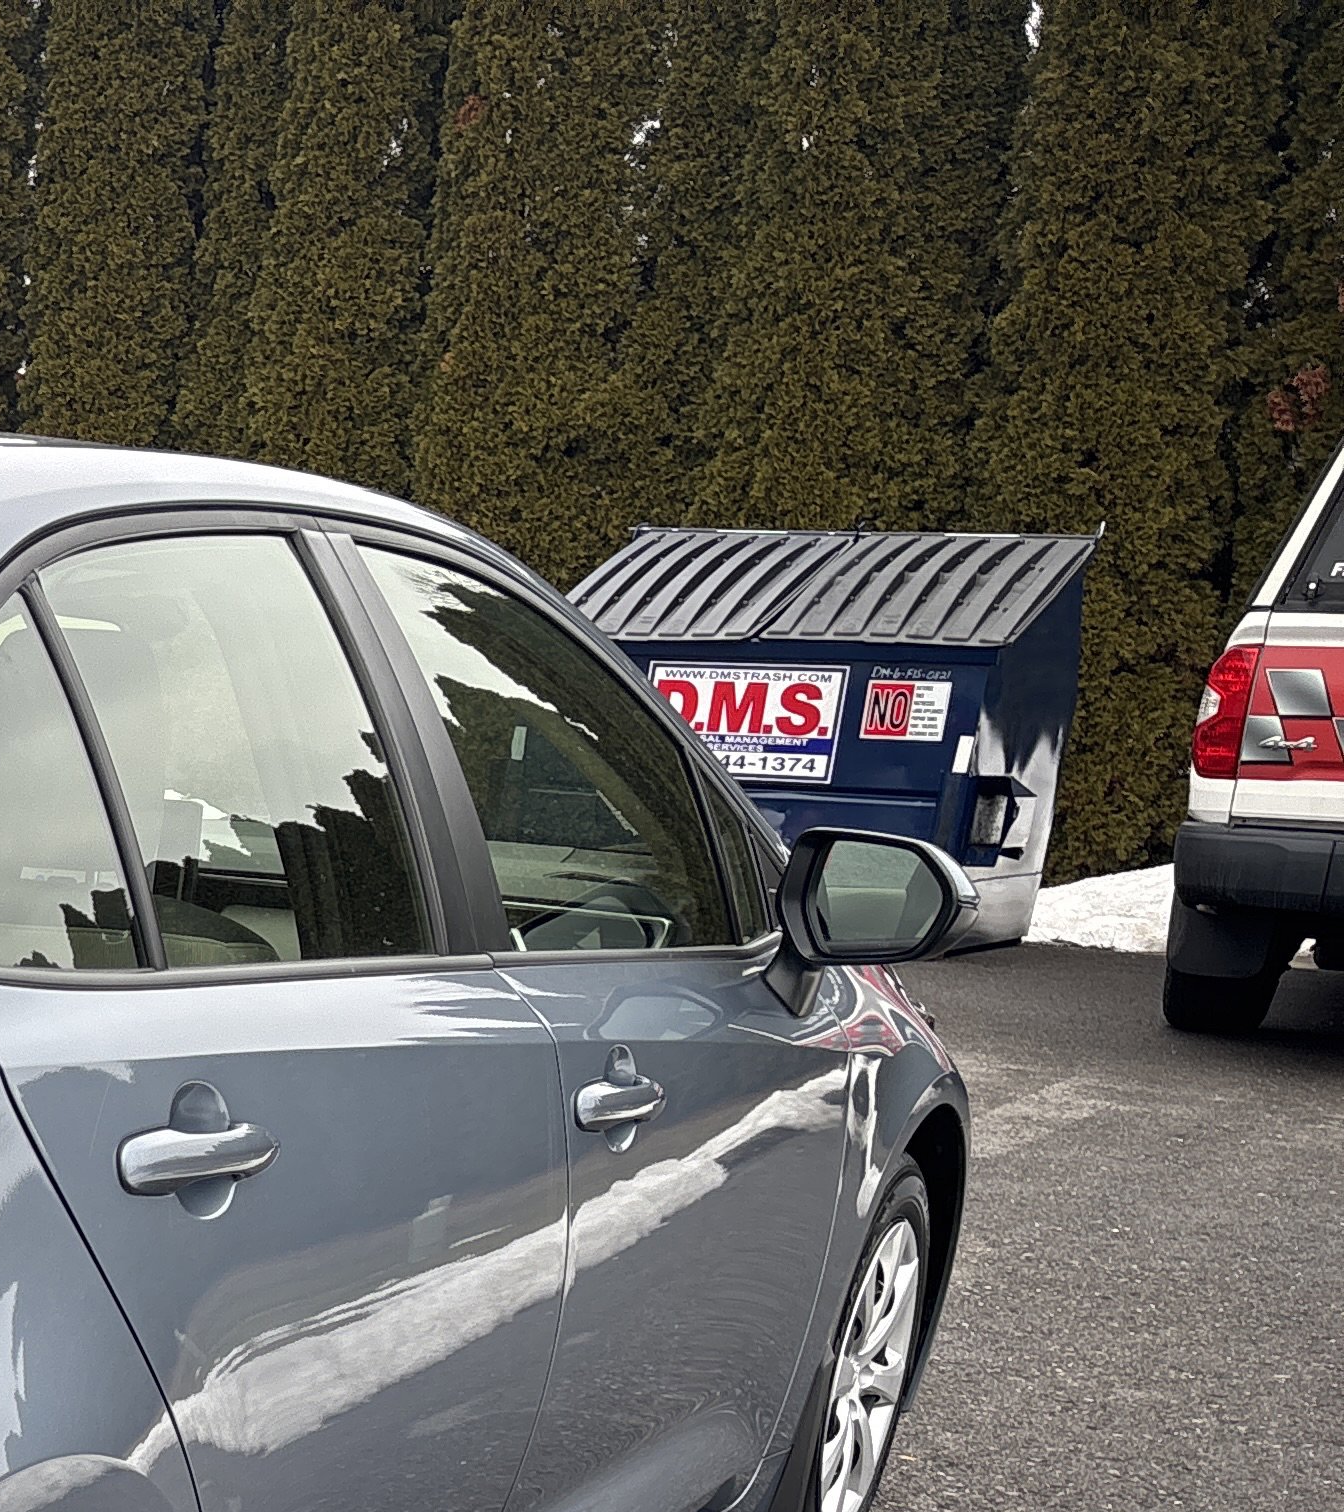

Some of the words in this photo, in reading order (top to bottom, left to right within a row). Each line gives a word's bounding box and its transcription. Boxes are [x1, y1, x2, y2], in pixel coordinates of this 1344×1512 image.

[664, 669, 833, 683] WWW.DMSTRASH.COM
[657, 679, 829, 736] D.M.S.
[866, 688, 911, 732] NO
[706, 742, 764, 753] SERVICES
[724, 735, 809, 747] MANAGEMENT
[719, 754, 816, 773] 44-1374
